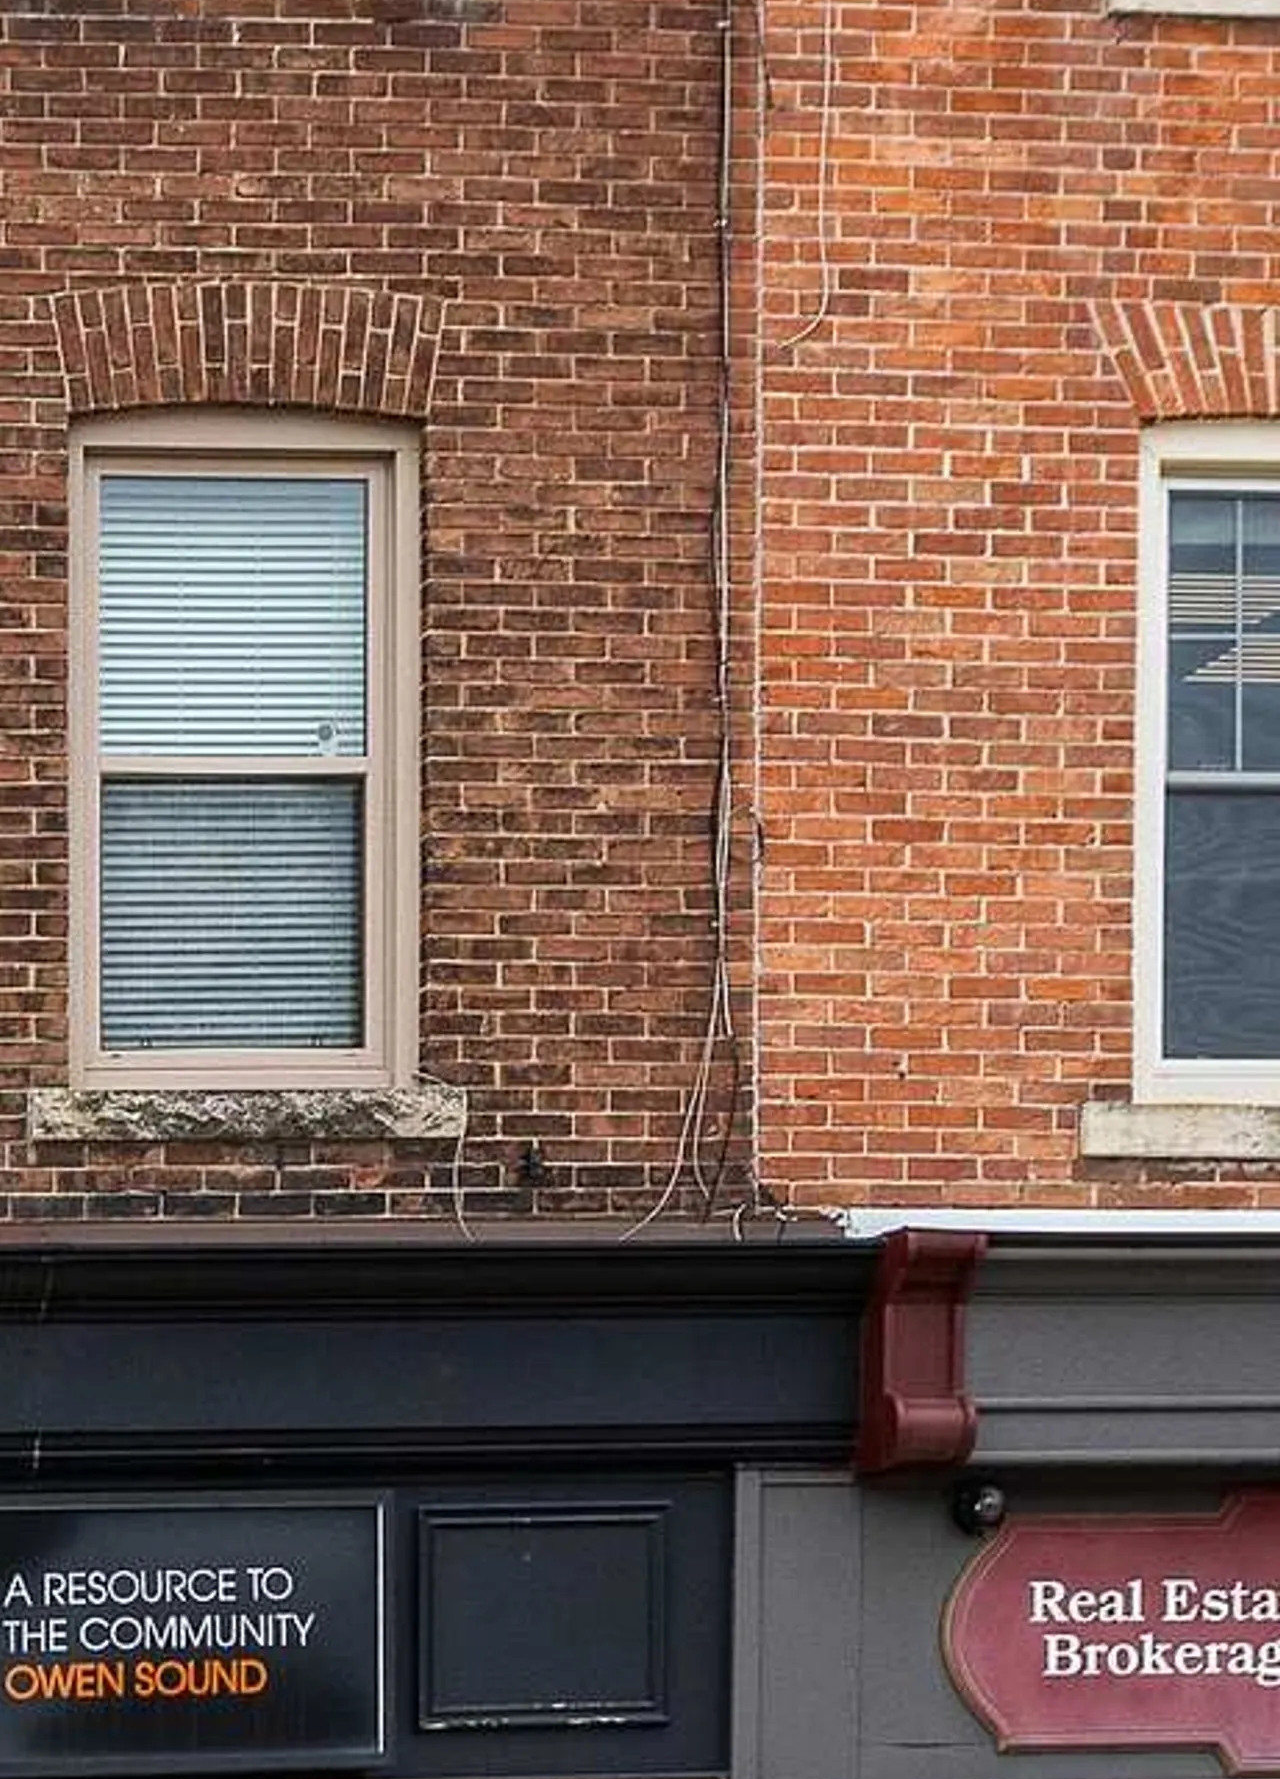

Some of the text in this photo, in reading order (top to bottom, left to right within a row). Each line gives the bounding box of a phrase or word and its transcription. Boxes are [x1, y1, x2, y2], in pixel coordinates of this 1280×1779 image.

[3, 1567, 292, 1608] A RESOURCE TO
[1028, 1579, 1144, 1623] Real
[3, 1614, 315, 1653] THE COMMUNITY
[4, 1658, 267, 1699] OWEN SOUND
